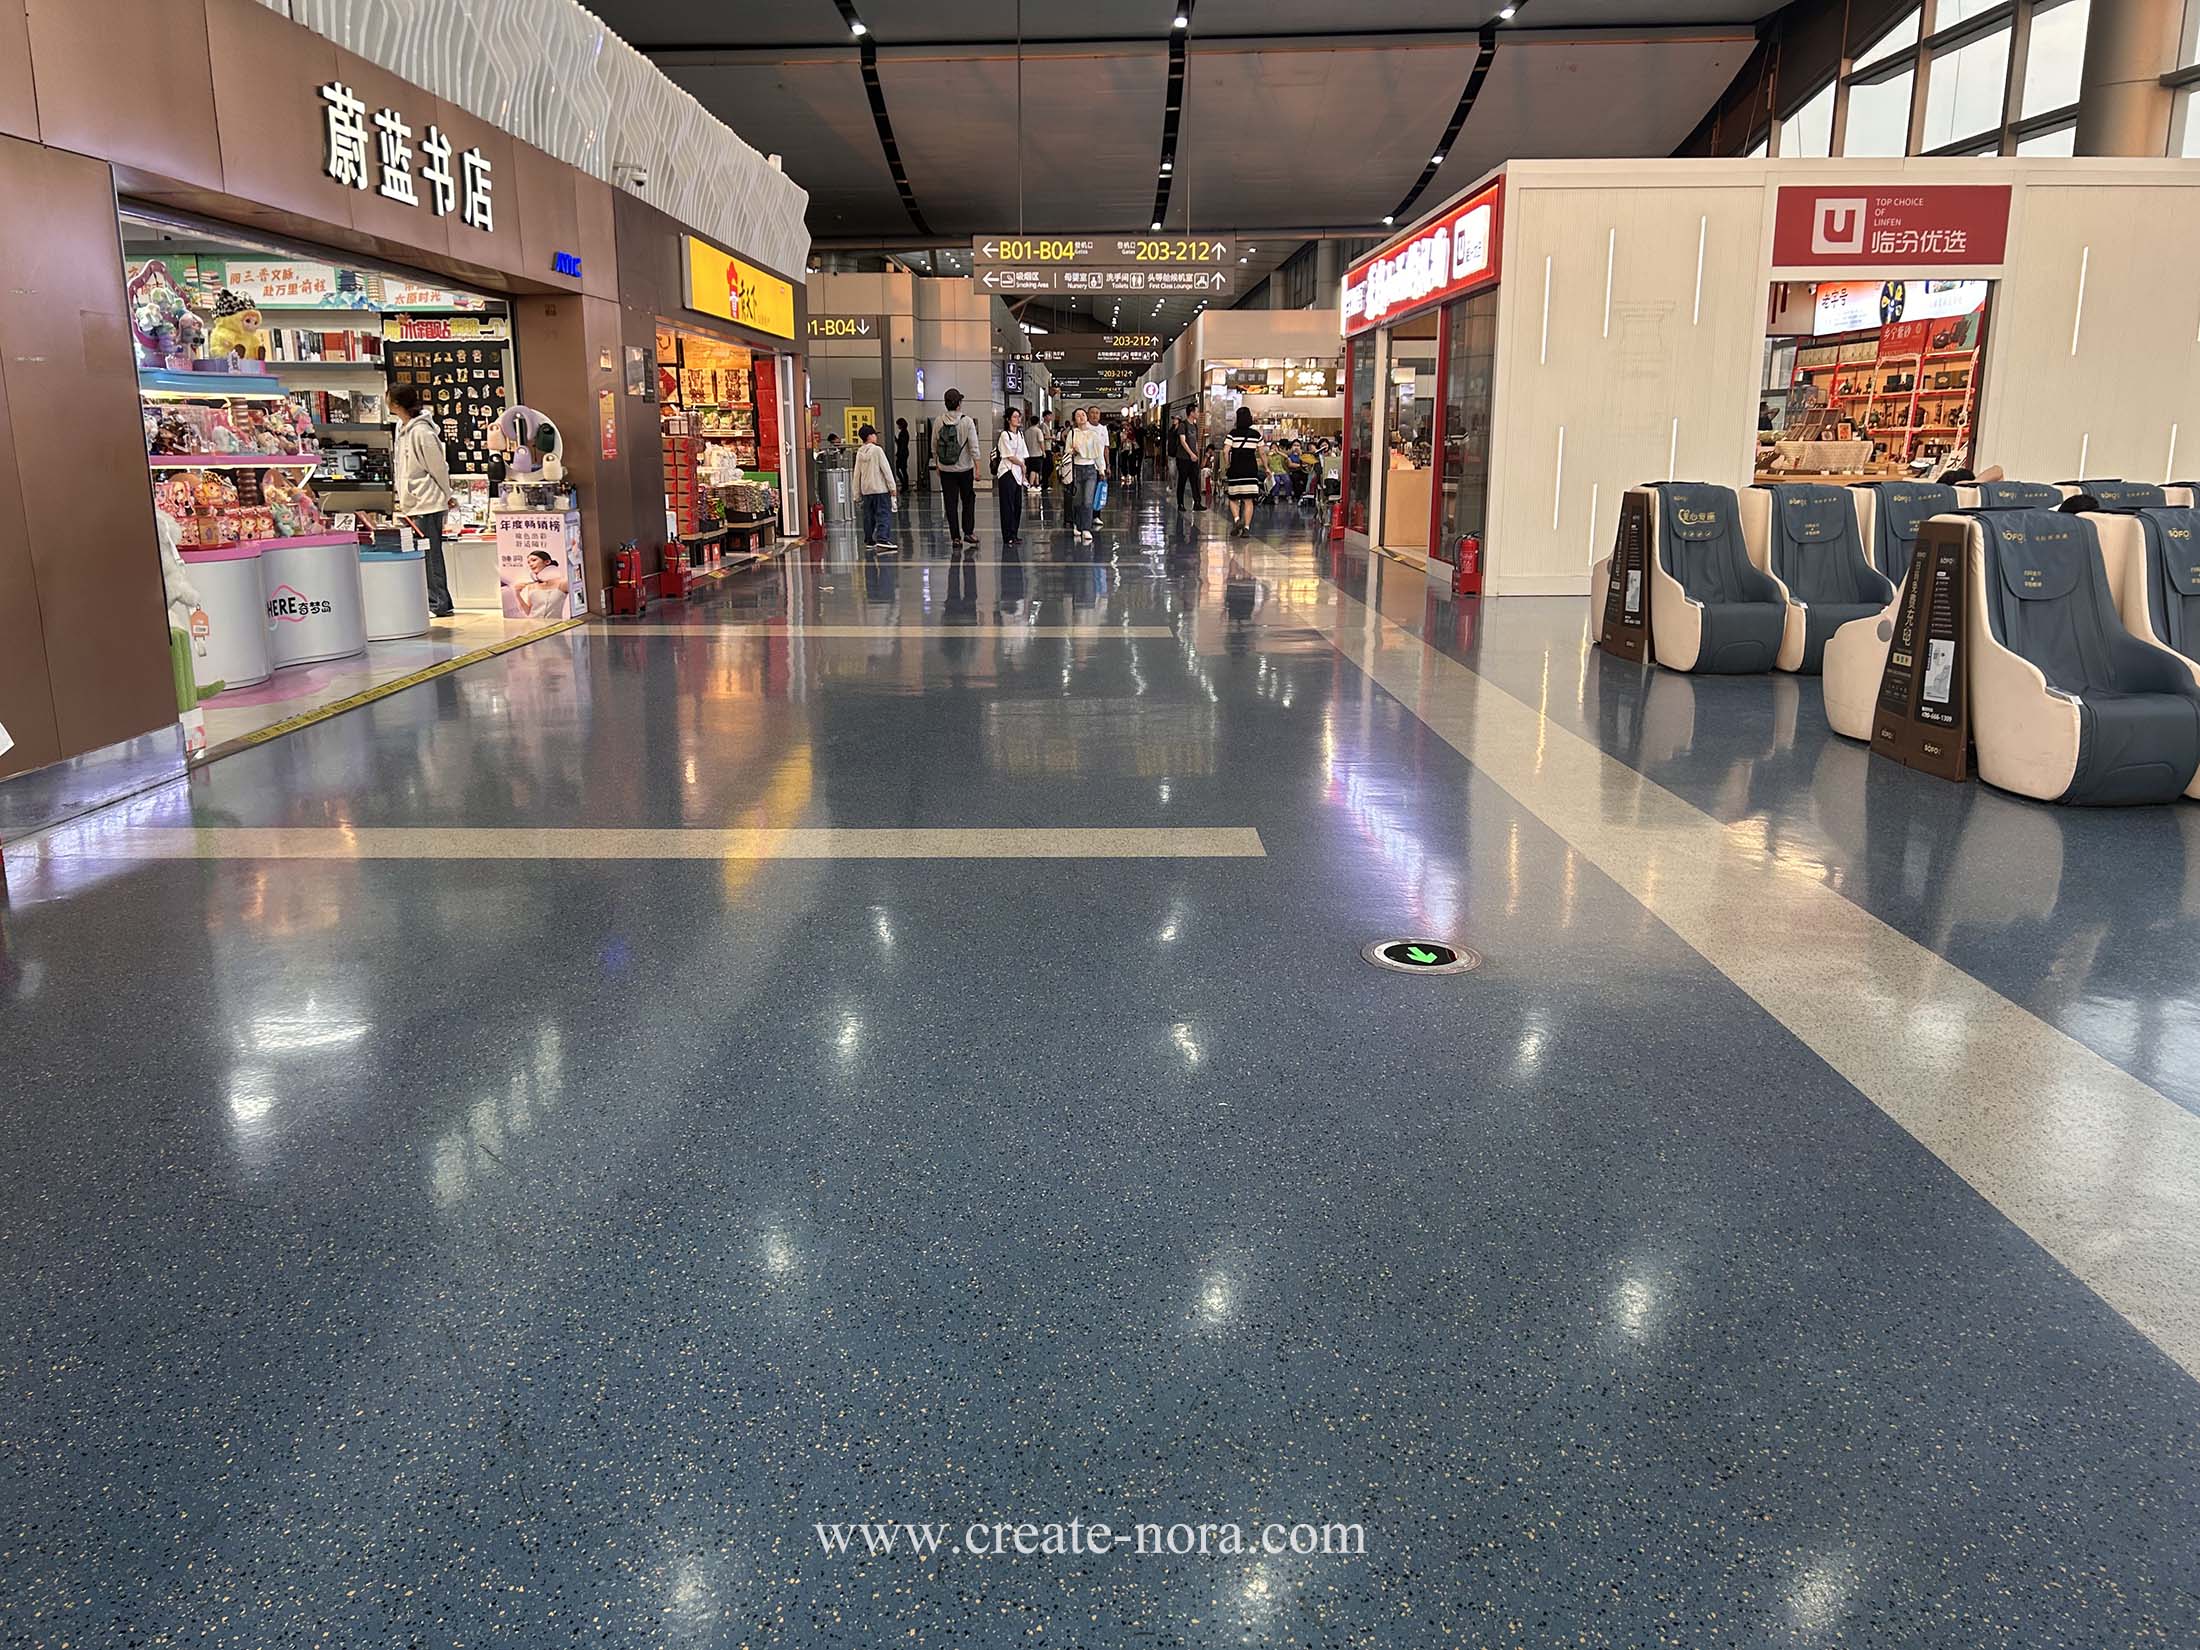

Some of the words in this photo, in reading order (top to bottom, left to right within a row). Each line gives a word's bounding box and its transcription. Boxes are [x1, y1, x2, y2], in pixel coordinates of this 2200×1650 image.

[321, 82, 494, 232] 蔚蓝书店
[1875, 198, 1893, 206] TOP
[1894, 198, 1924, 206] CHOICE
[1874, 208, 1886, 216] OF
[1873, 218, 1902, 227] LINFEN
[1871, 230, 1968, 253] 临汾优选
[1000, 241, 1075, 260] B01-B04
[1136, 241, 1210, 260] 203-212
[1016, 272, 1040, 281] 吸烟区
[1106, 272, 1129, 282] 洗手间
[1112, 336, 1150, 346] 203-212
[500, 519, 560, 533] 年度畅销榜
[267, 597, 297, 618] HERE
[298, 600, 332, 615] 奇梦岛
